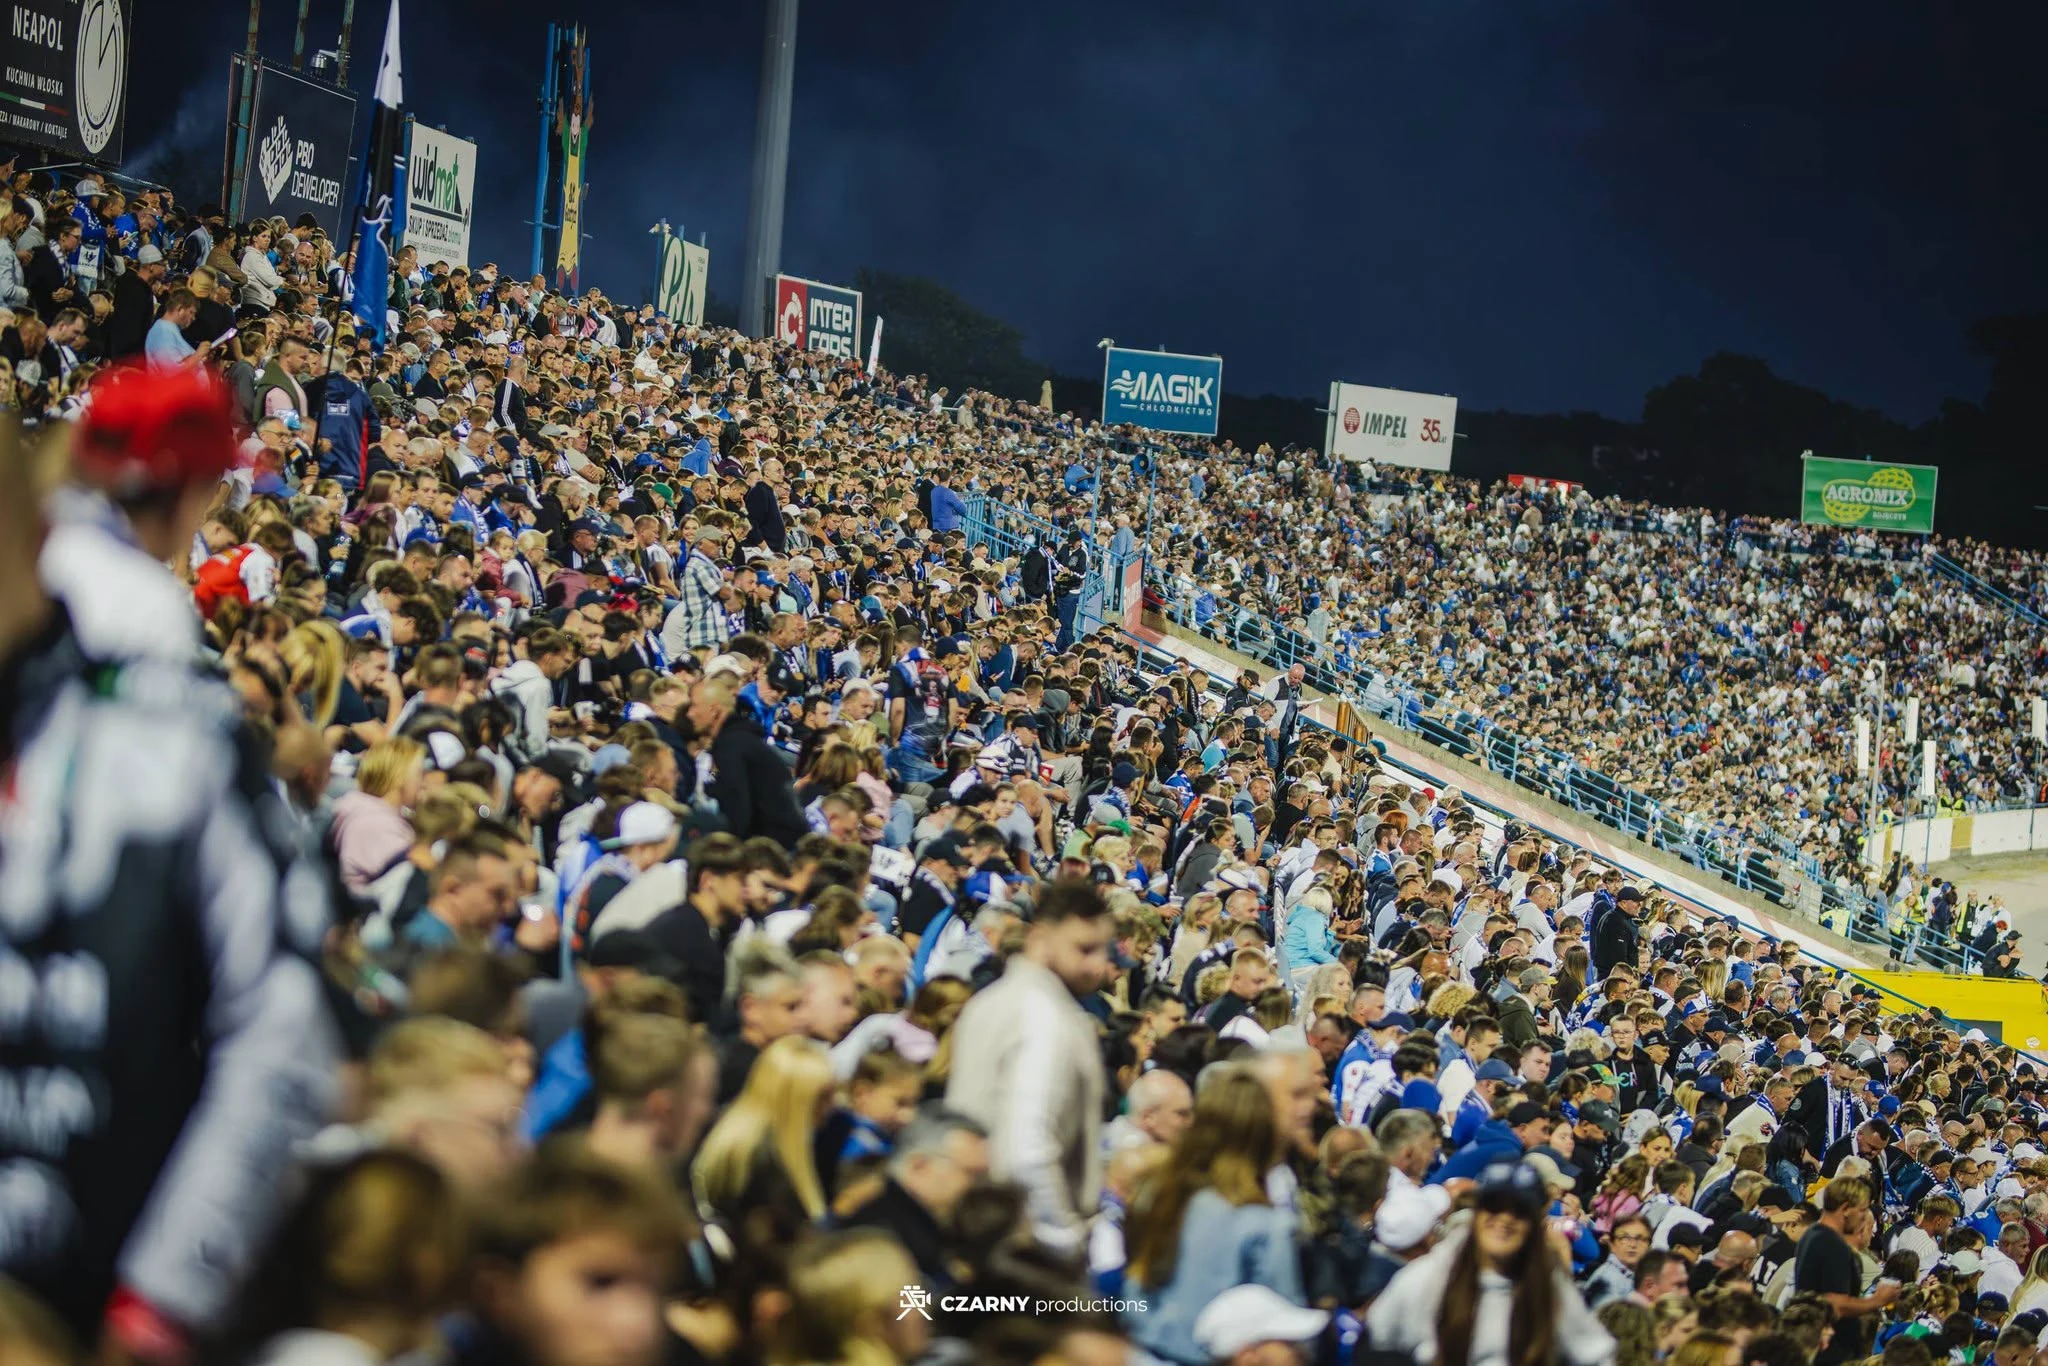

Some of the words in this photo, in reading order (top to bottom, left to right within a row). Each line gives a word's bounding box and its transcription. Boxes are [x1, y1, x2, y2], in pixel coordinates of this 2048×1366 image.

[12, 5, 64, 51] NEAPOL
[6, 66, 35, 88] KUCHNIA
[37, 75, 63, 96] WŁOSKA
[12, 114, 40, 132] MAKARONY
[295, 139, 315, 170] PBO
[291, 170, 340, 207] DEWELOPER
[809, 297, 853, 334] INTER
[1362, 411, 1408, 439] IMPEL
[1420, 417, 1441, 443] 35
[1825, 484, 1909, 506] AGROMIX
